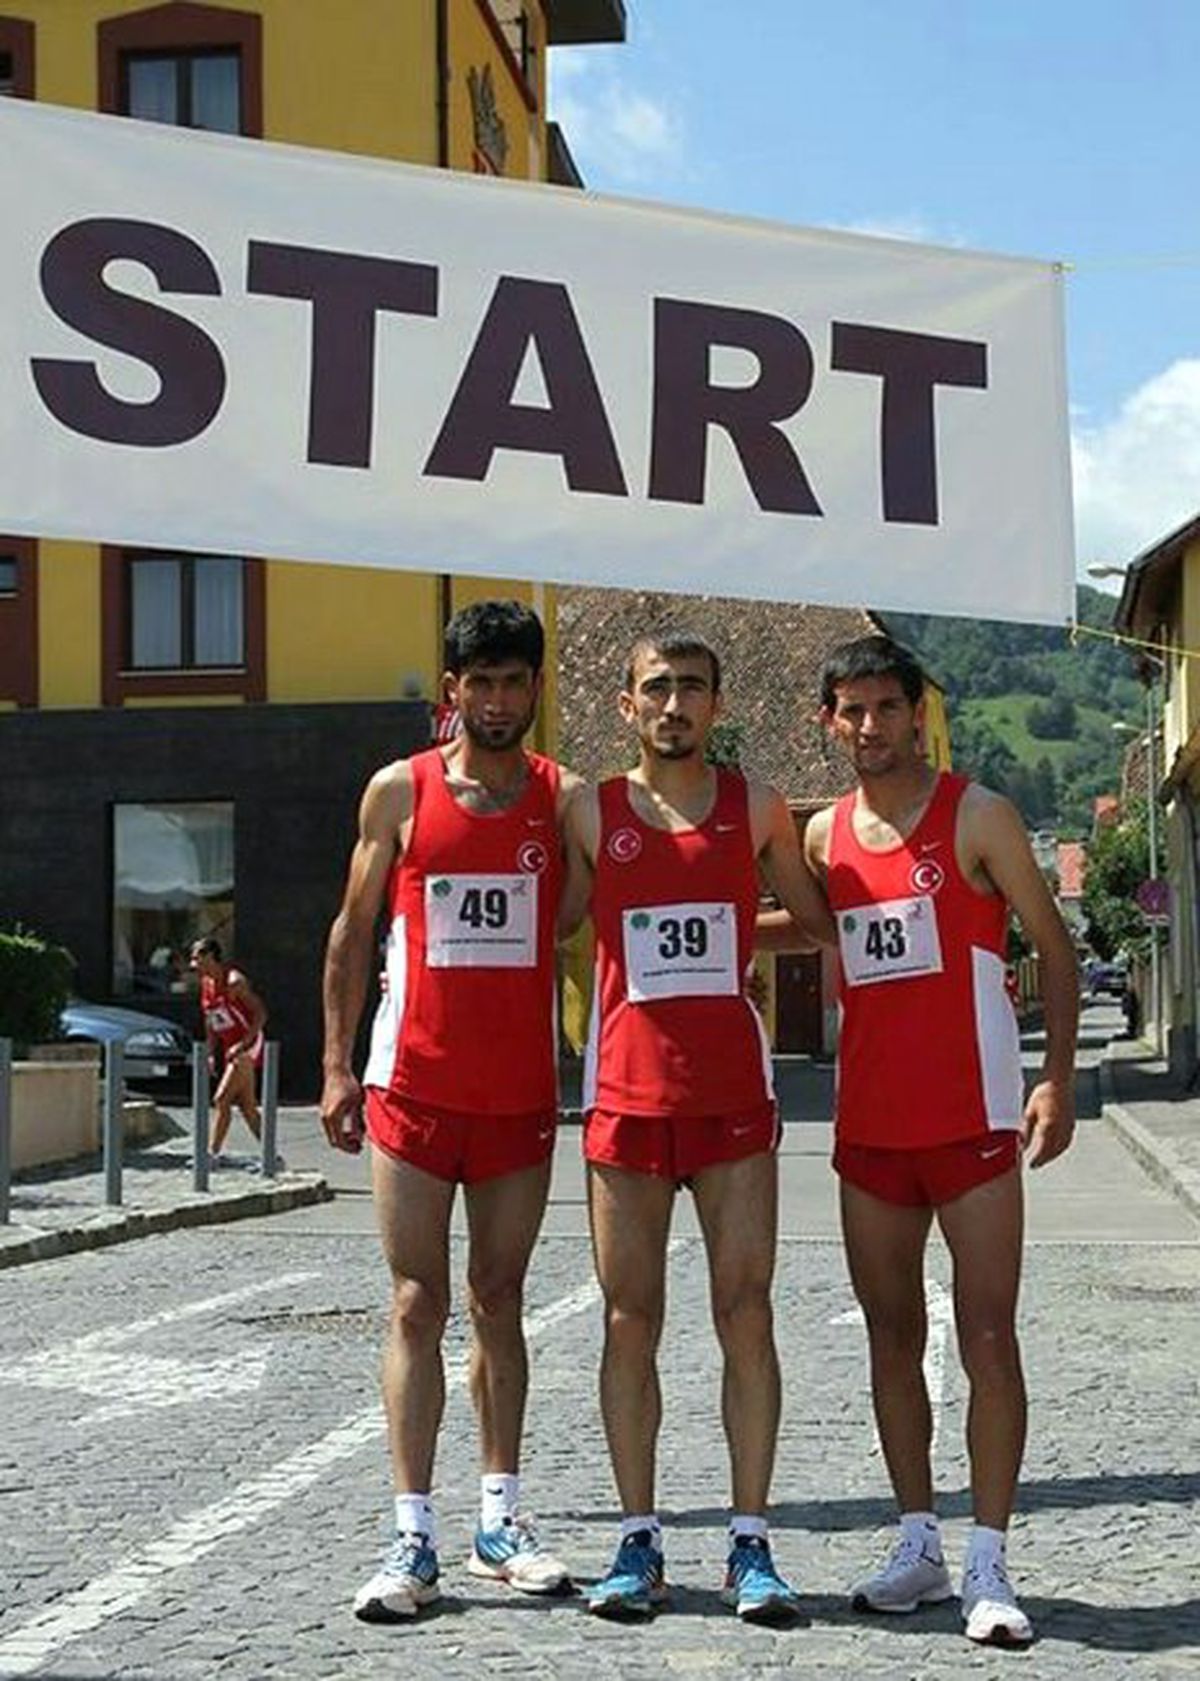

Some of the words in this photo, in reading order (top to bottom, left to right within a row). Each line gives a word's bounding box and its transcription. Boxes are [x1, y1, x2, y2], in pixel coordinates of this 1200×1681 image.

[30, 217, 988, 526] START
[459, 888, 507, 928] 49
[658, 917, 707, 959] 39
[866, 918, 905, 960] 43
